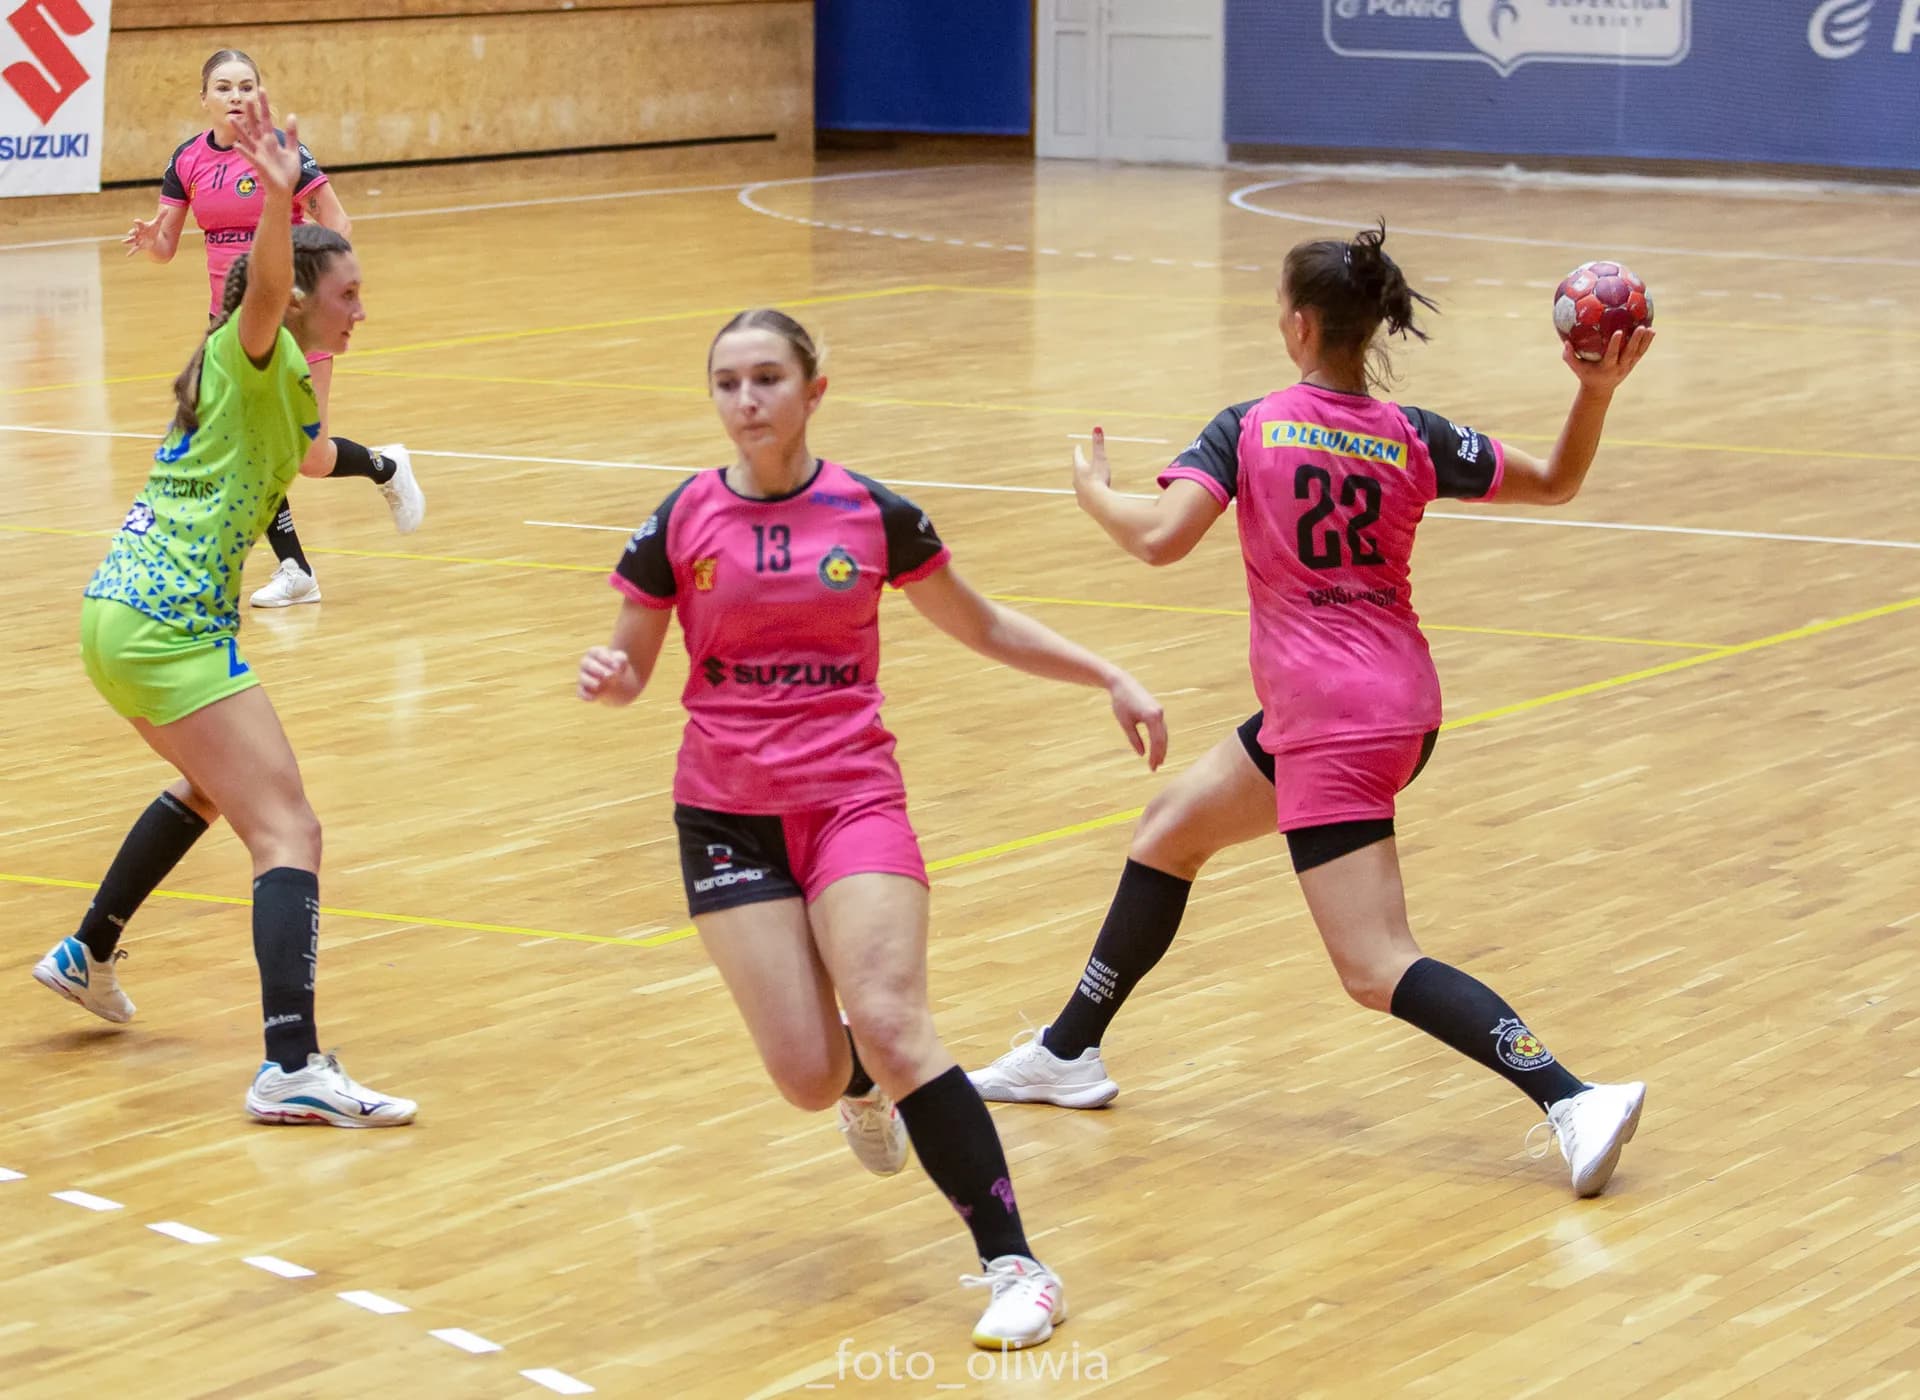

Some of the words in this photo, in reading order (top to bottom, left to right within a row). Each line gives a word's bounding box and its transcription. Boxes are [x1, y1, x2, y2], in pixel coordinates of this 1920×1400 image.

[0, 133, 89, 160] SUZUKI
[212, 164, 228, 190] 11
[207, 231, 254, 244] SUZU
[1298, 426, 1401, 462] LEWIATAN
[1295, 463, 1387, 571] 22
[751, 525, 792, 574] 13
[733, 662, 860, 687] SUZUKI
